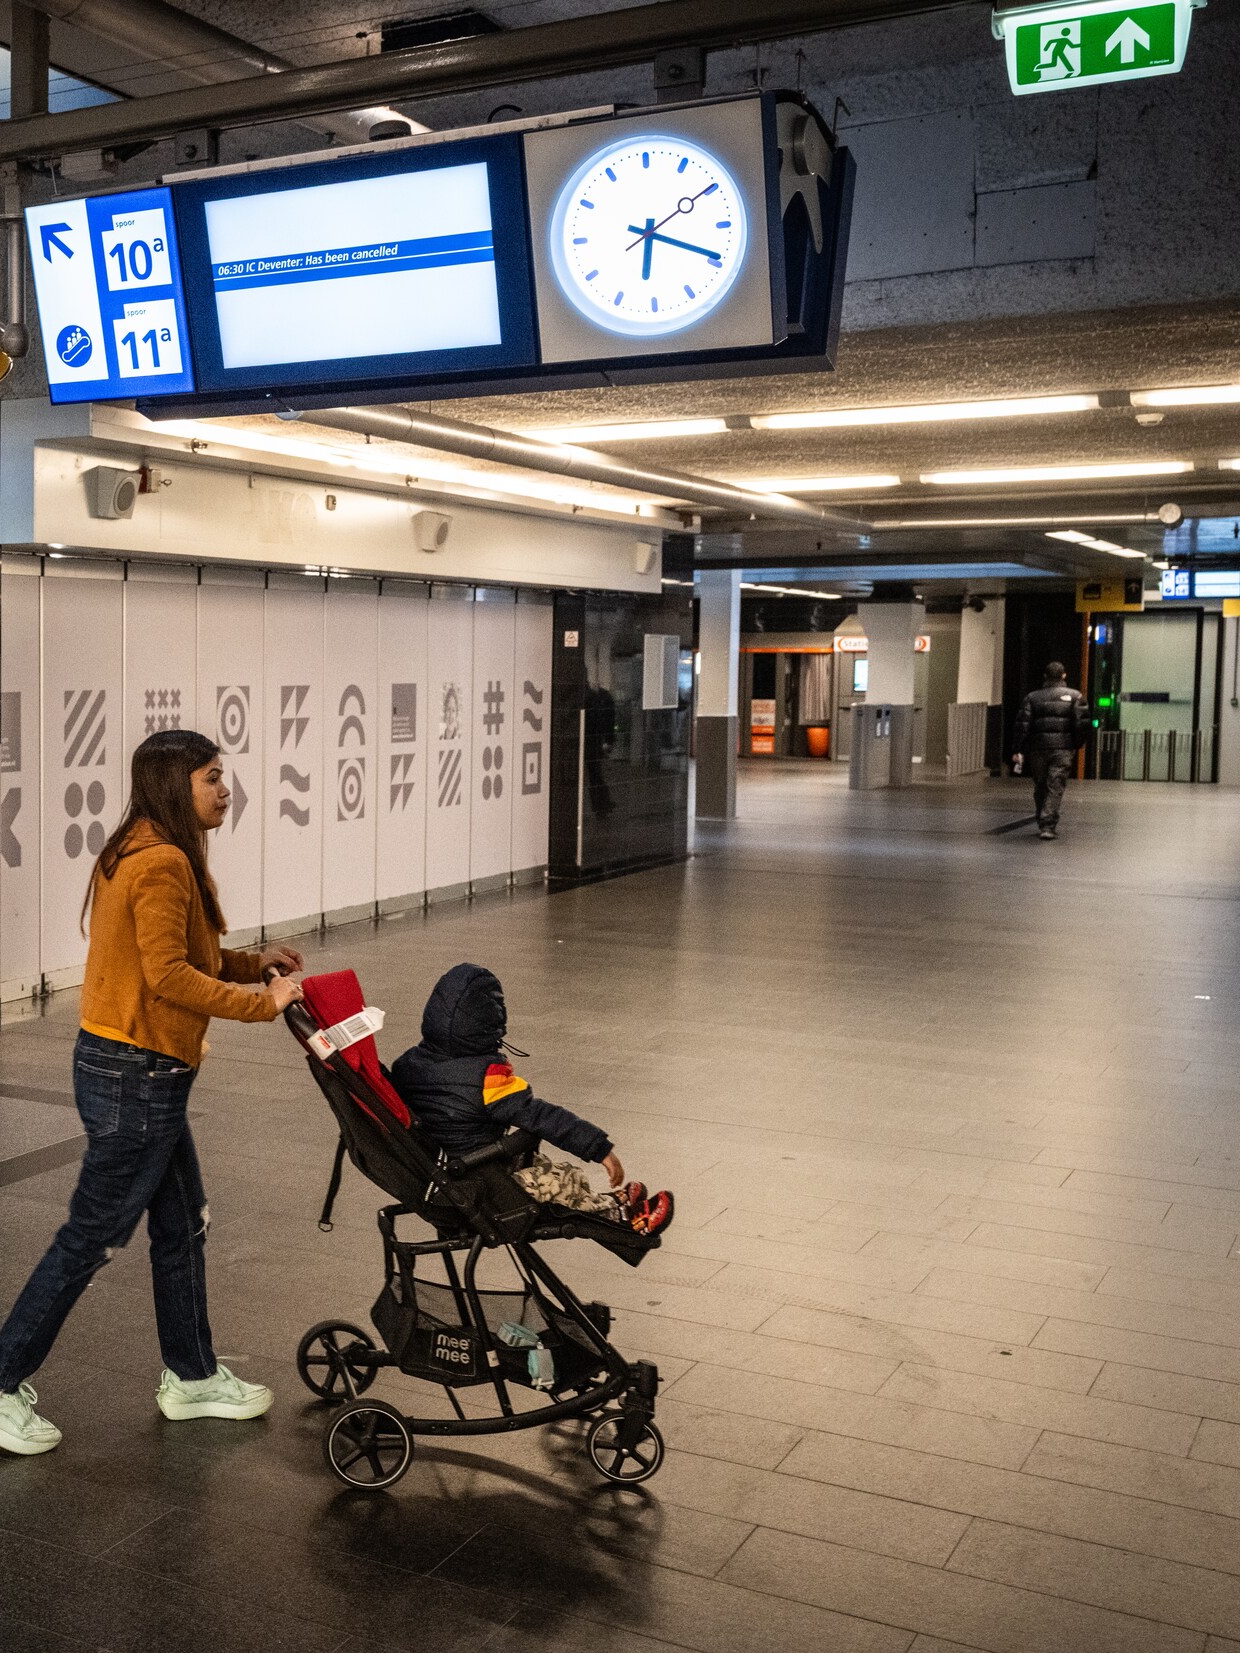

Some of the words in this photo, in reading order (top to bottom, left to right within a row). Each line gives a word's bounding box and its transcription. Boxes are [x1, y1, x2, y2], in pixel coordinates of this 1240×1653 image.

[115, 219, 135, 229] spoor
[218, 263, 244, 276] 06:30
[245, 262, 256, 273] IC
[257, 257, 304, 272] Deventer:
[305, 254, 323, 266] Has
[325, 252, 349, 264] been
[351, 243, 399, 260] cancelled
[126, 309, 147, 317] spoor
[436, 1333, 470, 1351] mee
[435, 1347, 471, 1364] mee
